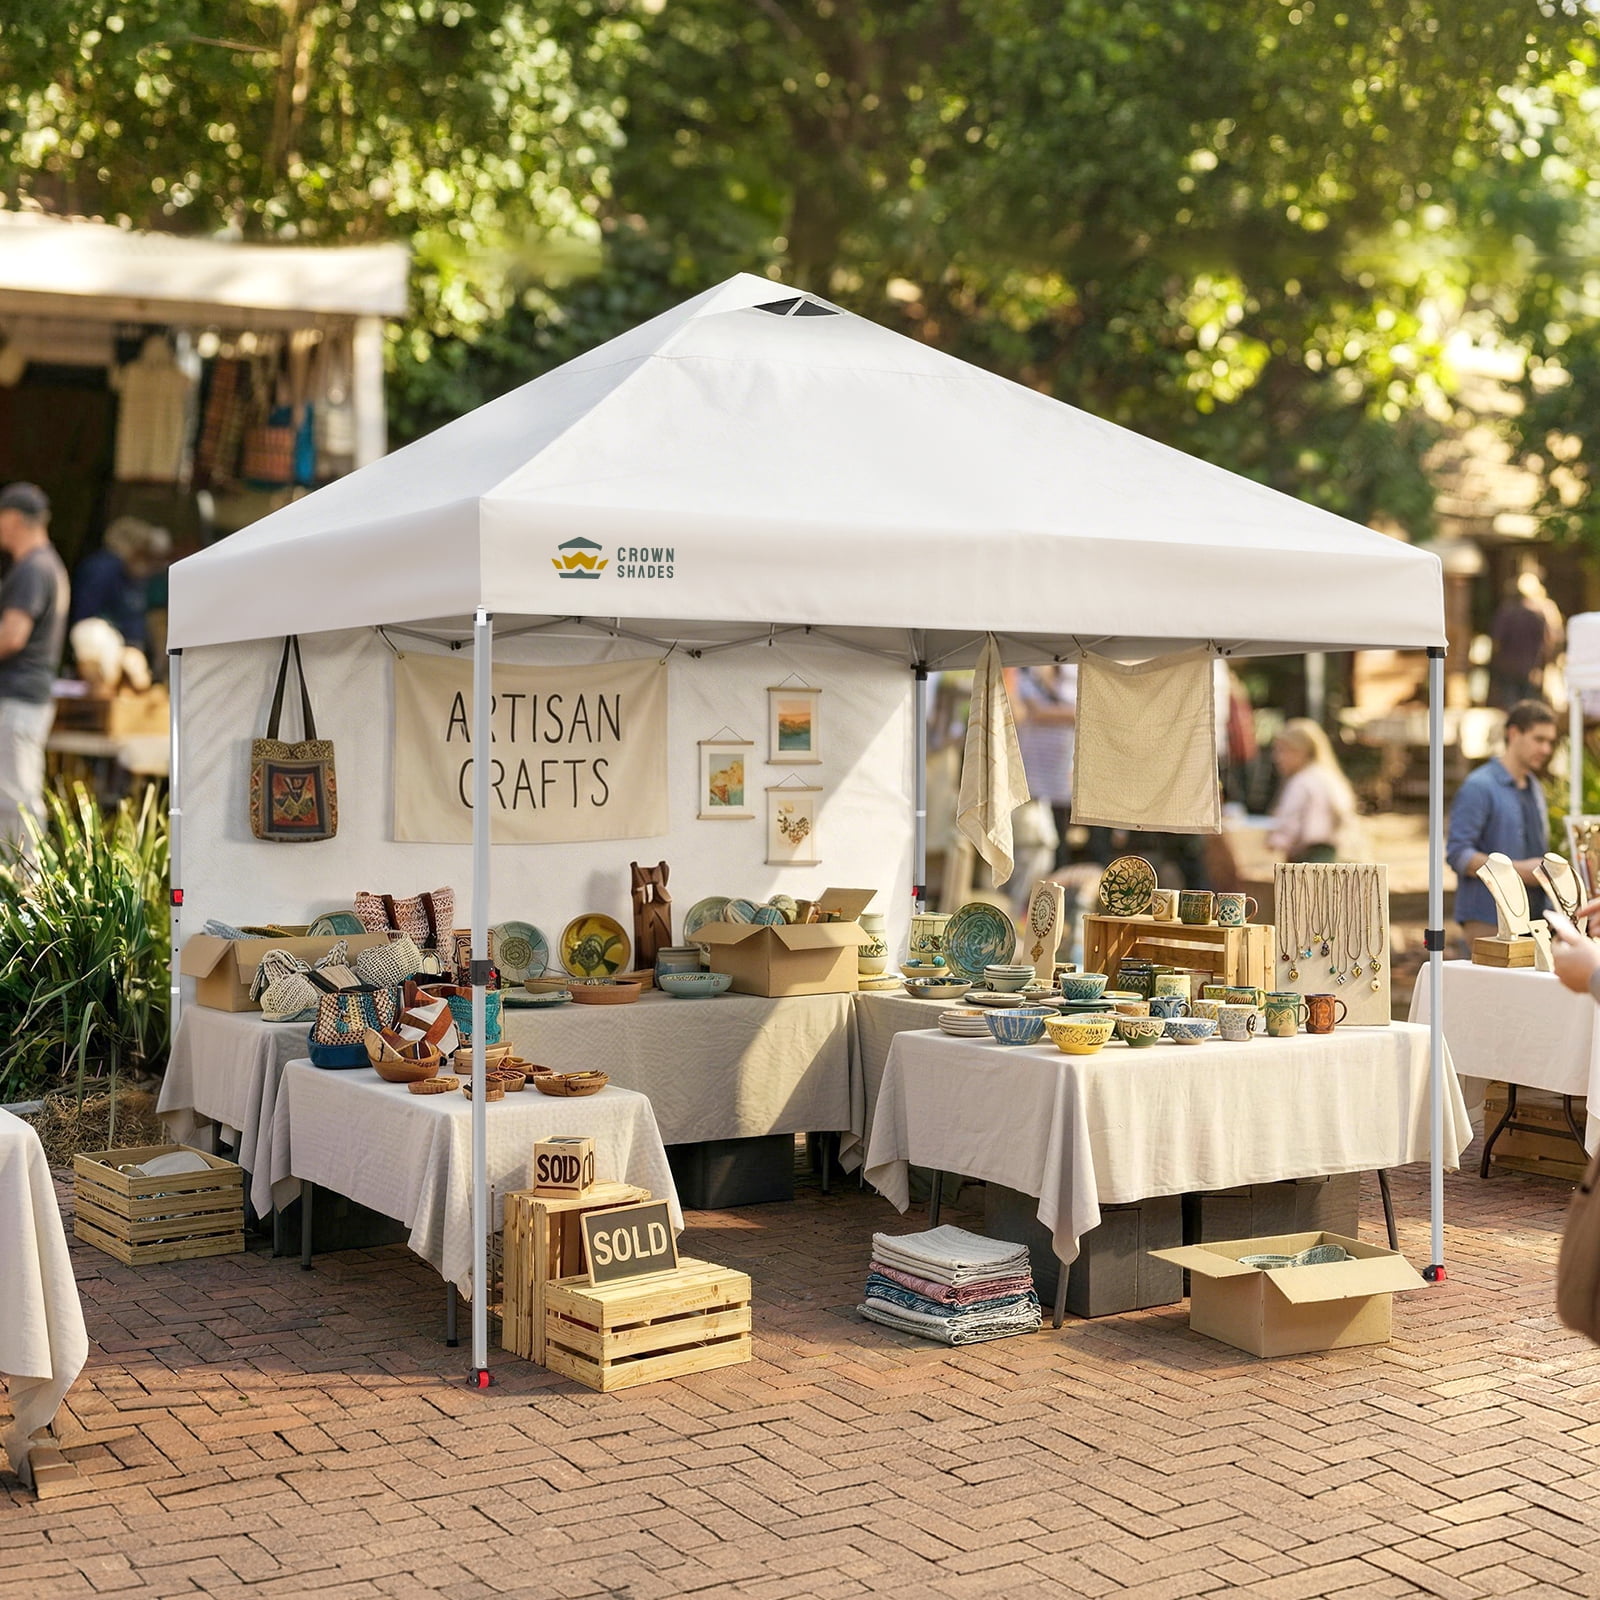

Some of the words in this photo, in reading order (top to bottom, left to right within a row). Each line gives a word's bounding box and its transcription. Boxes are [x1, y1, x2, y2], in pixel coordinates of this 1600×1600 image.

[617, 547, 675, 562] CROWN
[617, 565, 674, 579] SHADES
[537, 1153, 581, 1184] SOLD
[593, 1222, 668, 1266] SOLD
